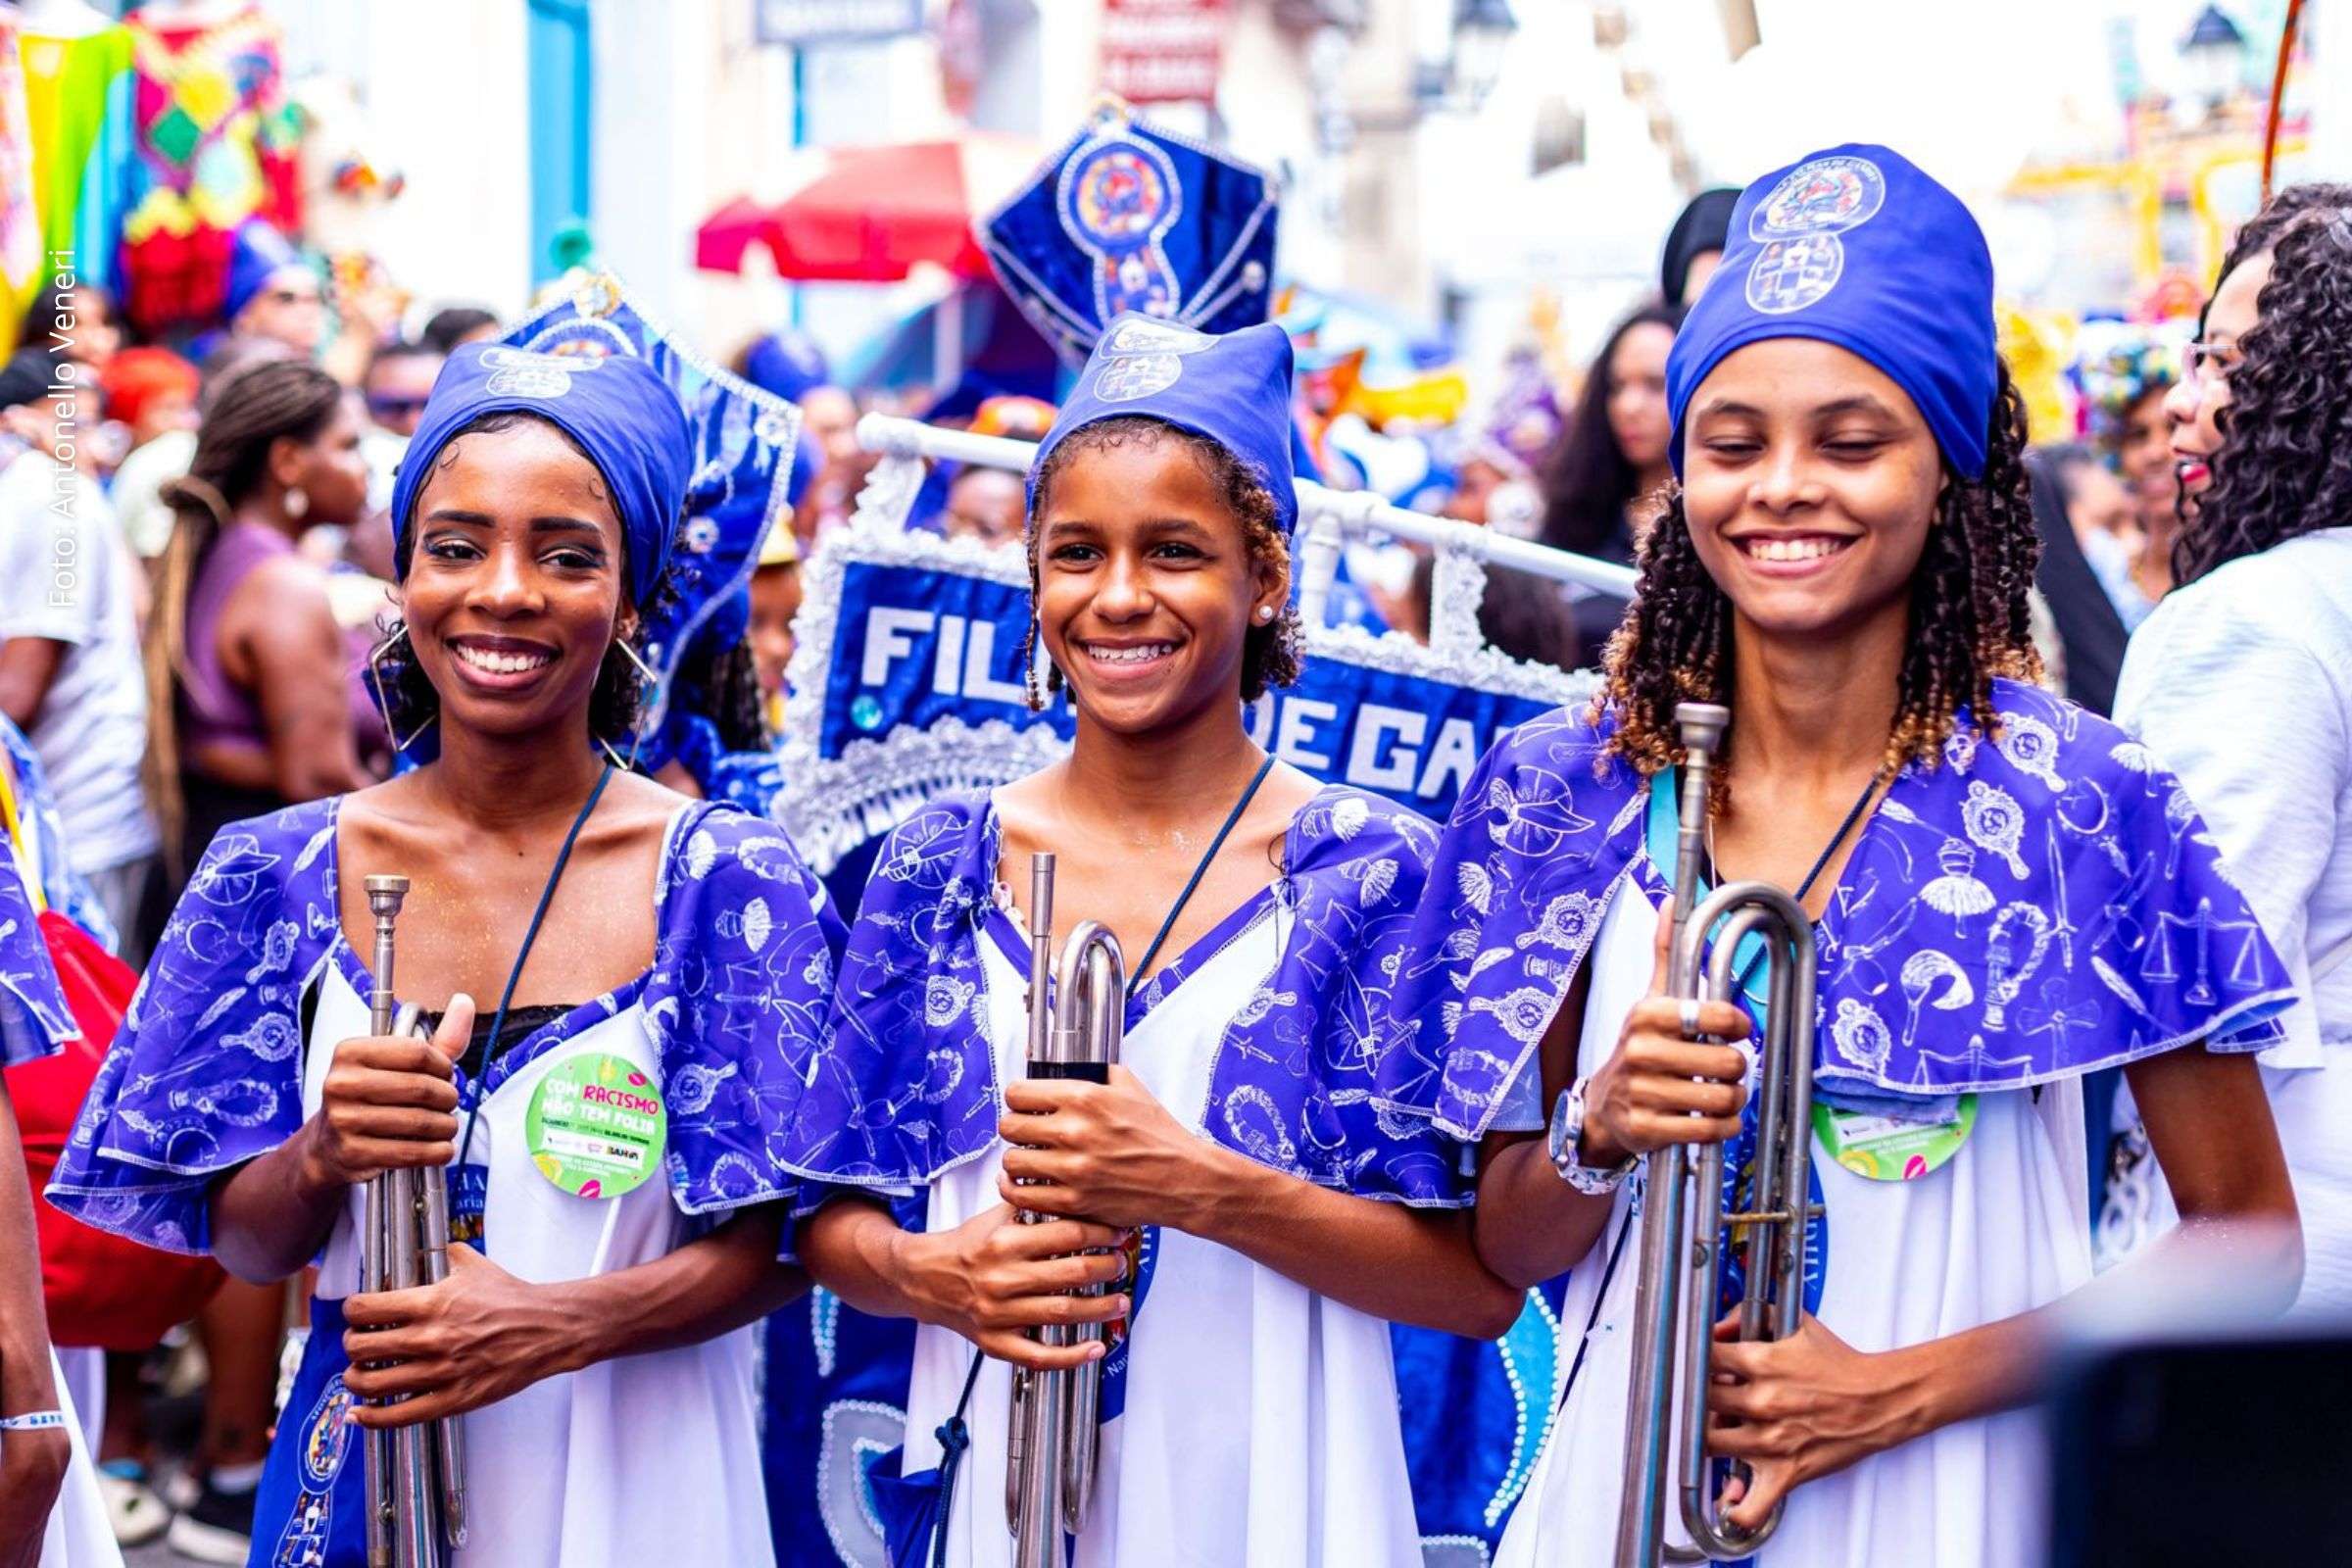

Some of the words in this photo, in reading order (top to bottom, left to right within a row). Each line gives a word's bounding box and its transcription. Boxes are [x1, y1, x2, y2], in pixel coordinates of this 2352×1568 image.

[1346, 702, 1519, 800] GA
[545, 1078, 580, 1099] COM
[582, 1084, 660, 1115] RACISMO
[580, 1102, 612, 1125] TEM
